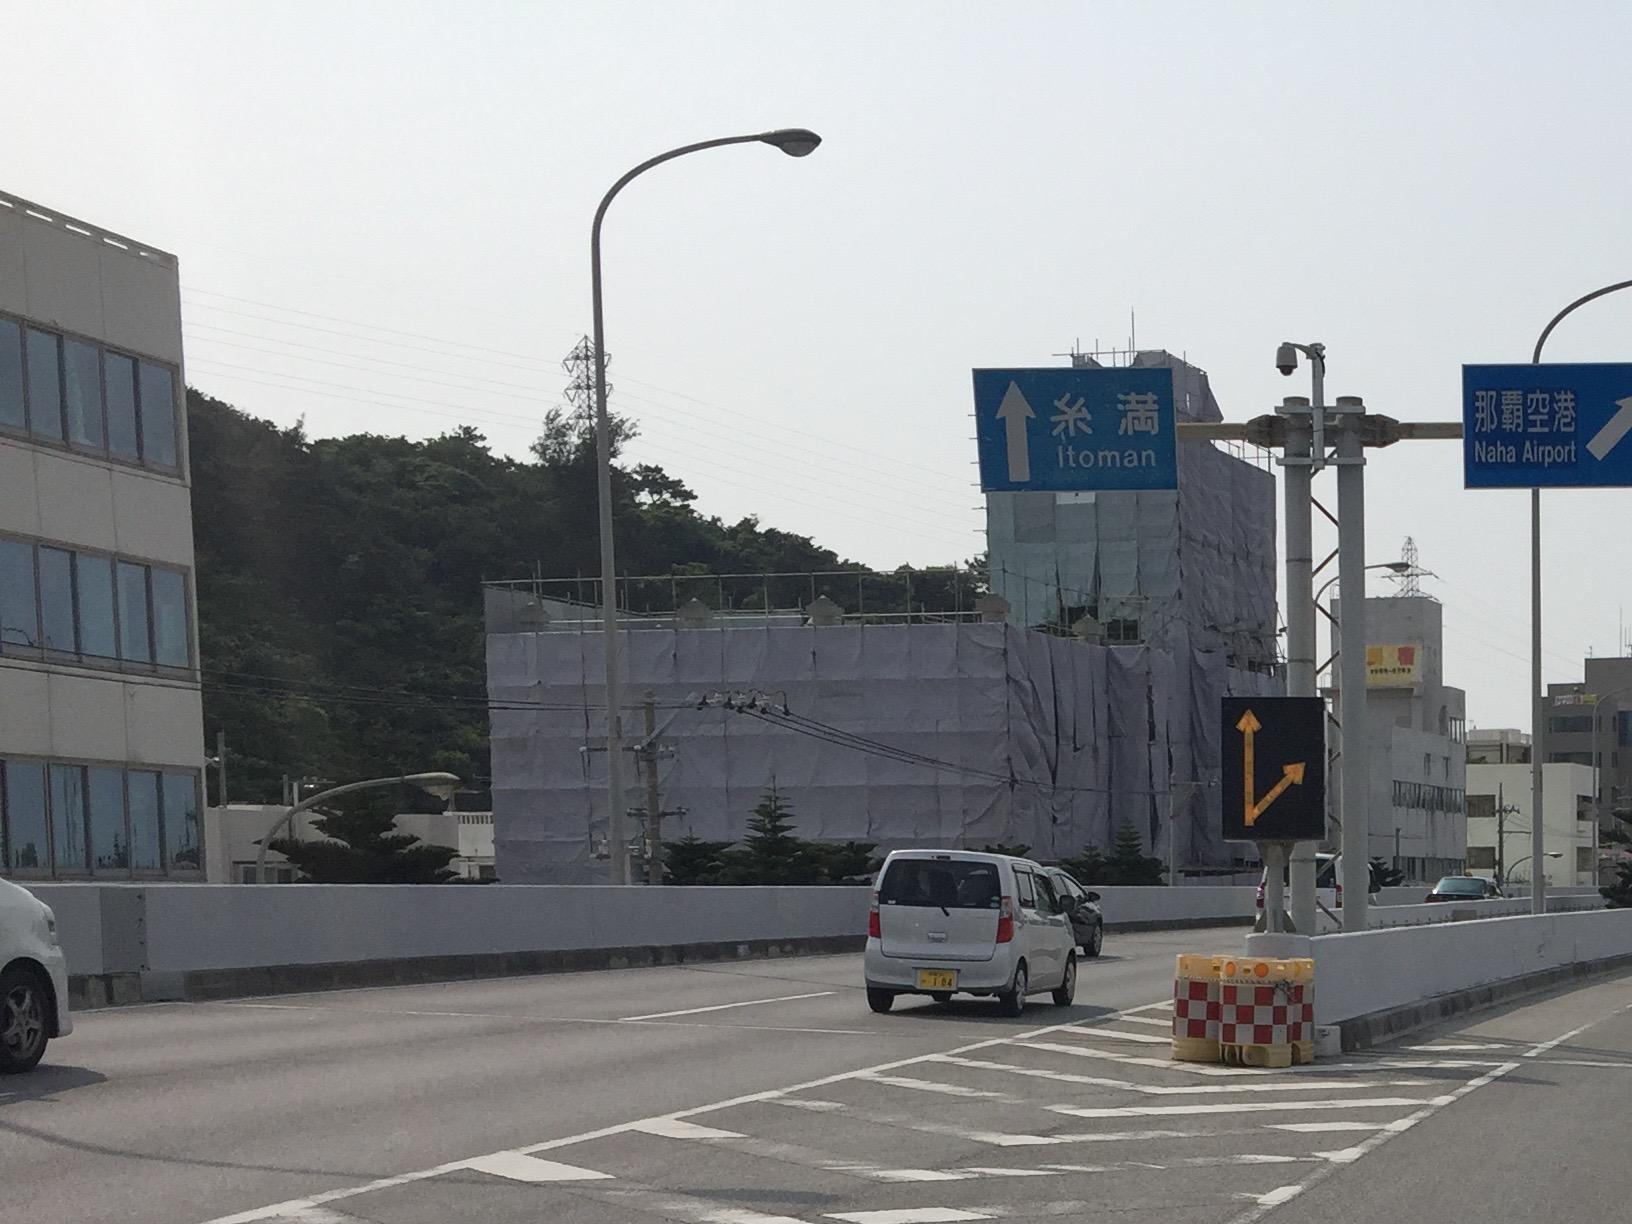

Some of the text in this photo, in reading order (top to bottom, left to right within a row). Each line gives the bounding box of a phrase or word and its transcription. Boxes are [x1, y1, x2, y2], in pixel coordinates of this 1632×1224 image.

[1050, 391, 1160, 437] 糸満
[1474, 389, 1577, 434] 那覇空港
[1058, 445, 1157, 469] Itoman
[1474, 440, 1577, 468] Naha Airport
